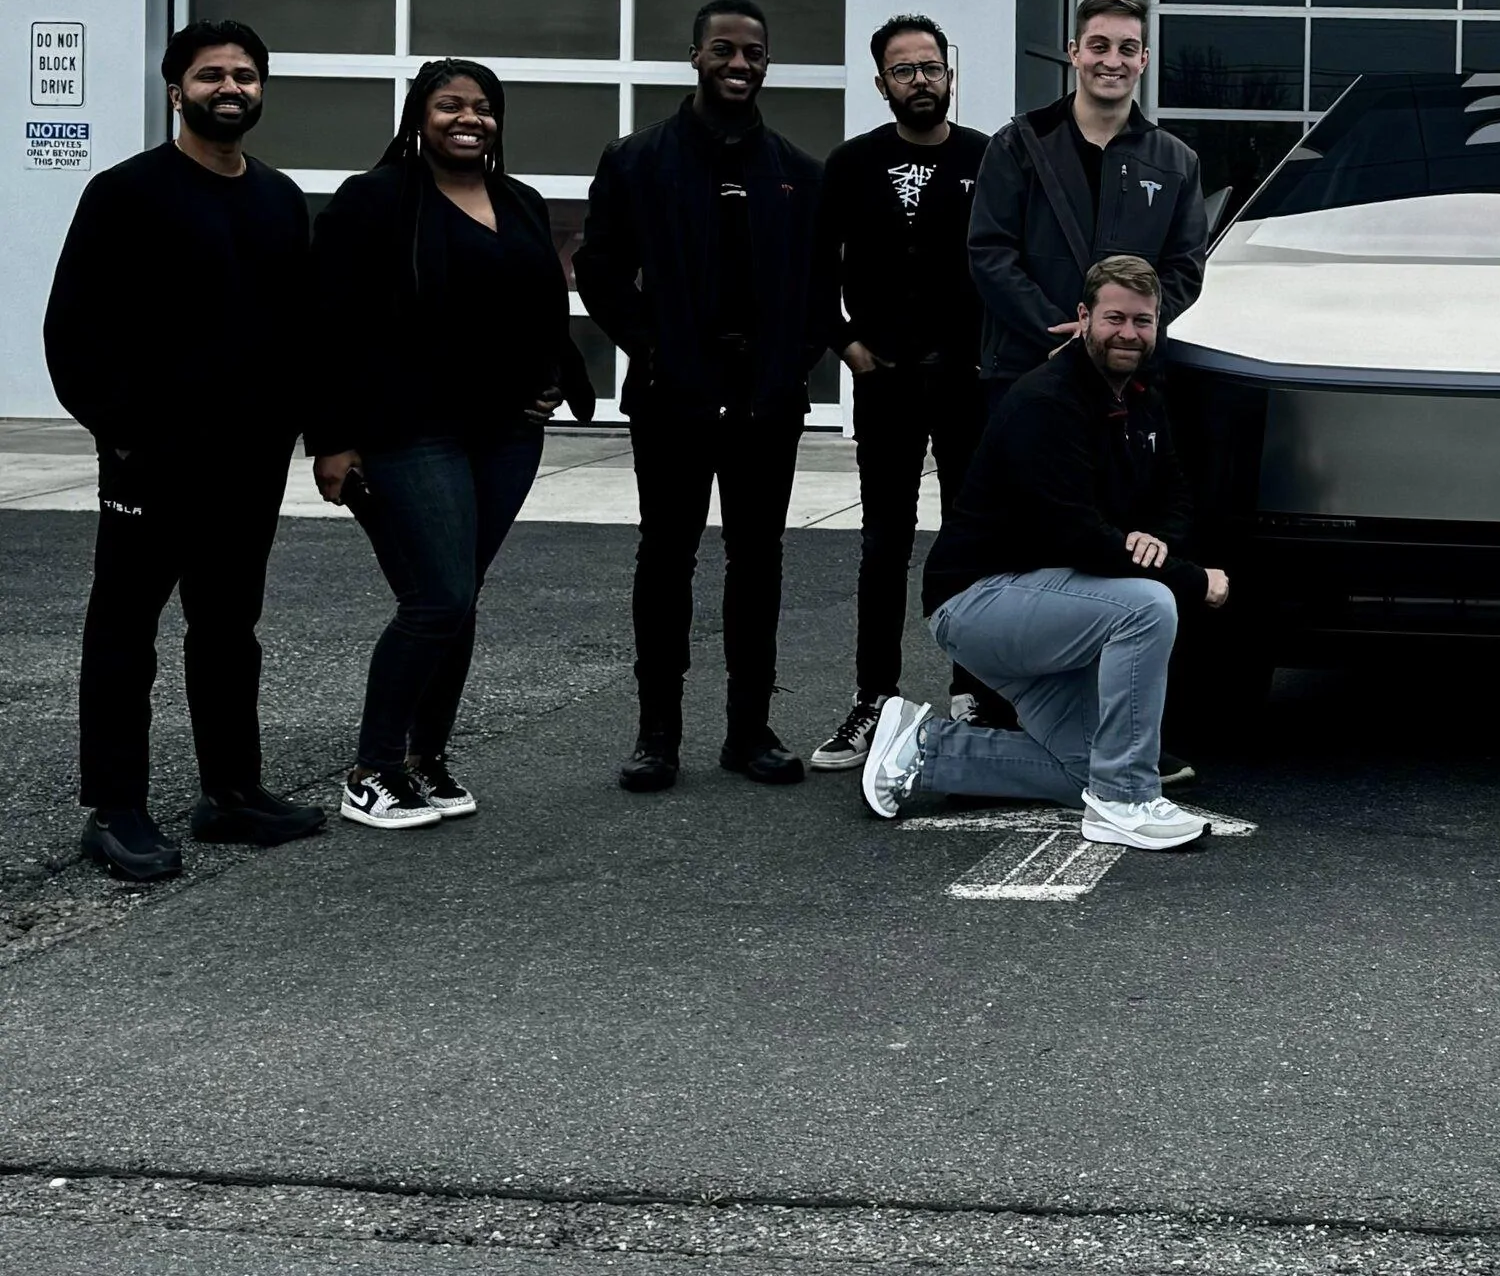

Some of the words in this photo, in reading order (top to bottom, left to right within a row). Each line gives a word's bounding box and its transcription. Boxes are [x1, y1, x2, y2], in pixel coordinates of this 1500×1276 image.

[37, 33, 52, 48] DO
[57, 33, 79, 48] NOT
[39, 56, 76, 71] BLOCK
[41, 79, 75, 94] DRIVE
[29, 123, 87, 138] NOTICE
[31, 140, 82, 148] EMPLOYEES
[26, 149, 50, 157] ONLY
[52, 149, 88, 158] BEYOND
[34, 157, 53, 166] THIS
[55, 158, 81, 166] POINT
